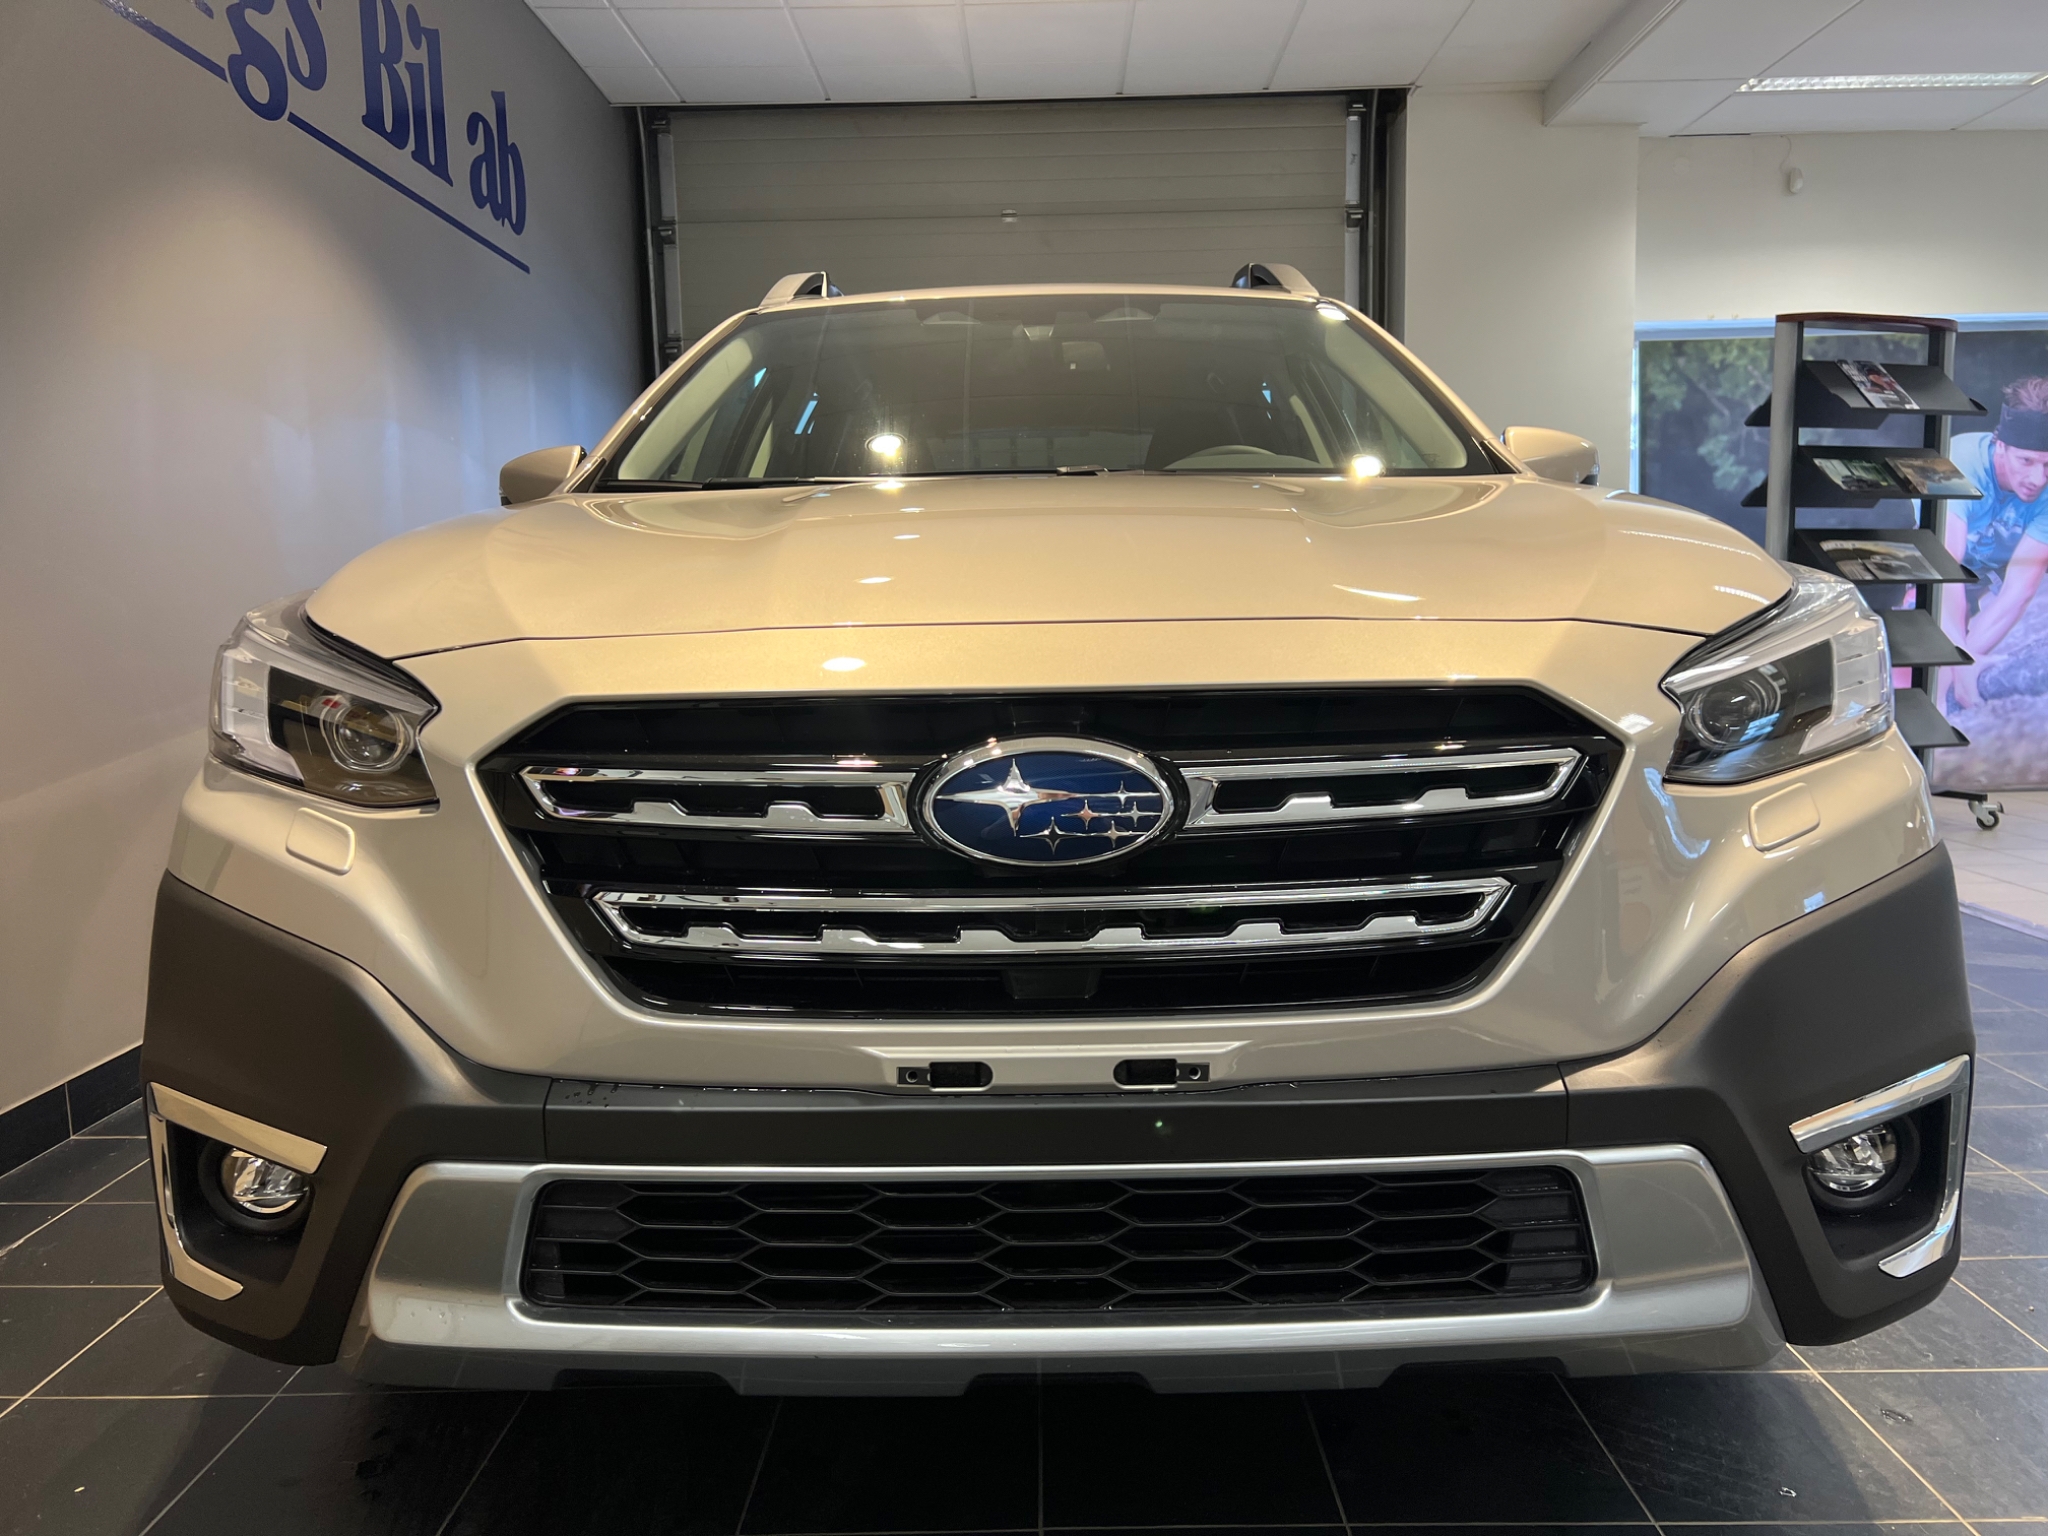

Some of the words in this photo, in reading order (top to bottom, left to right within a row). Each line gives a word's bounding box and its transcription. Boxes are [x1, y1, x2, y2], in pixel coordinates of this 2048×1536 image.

[188, 0, 328, 122] gs
[359, 0, 454, 188] Bil
[466, 90, 527, 236] ab
